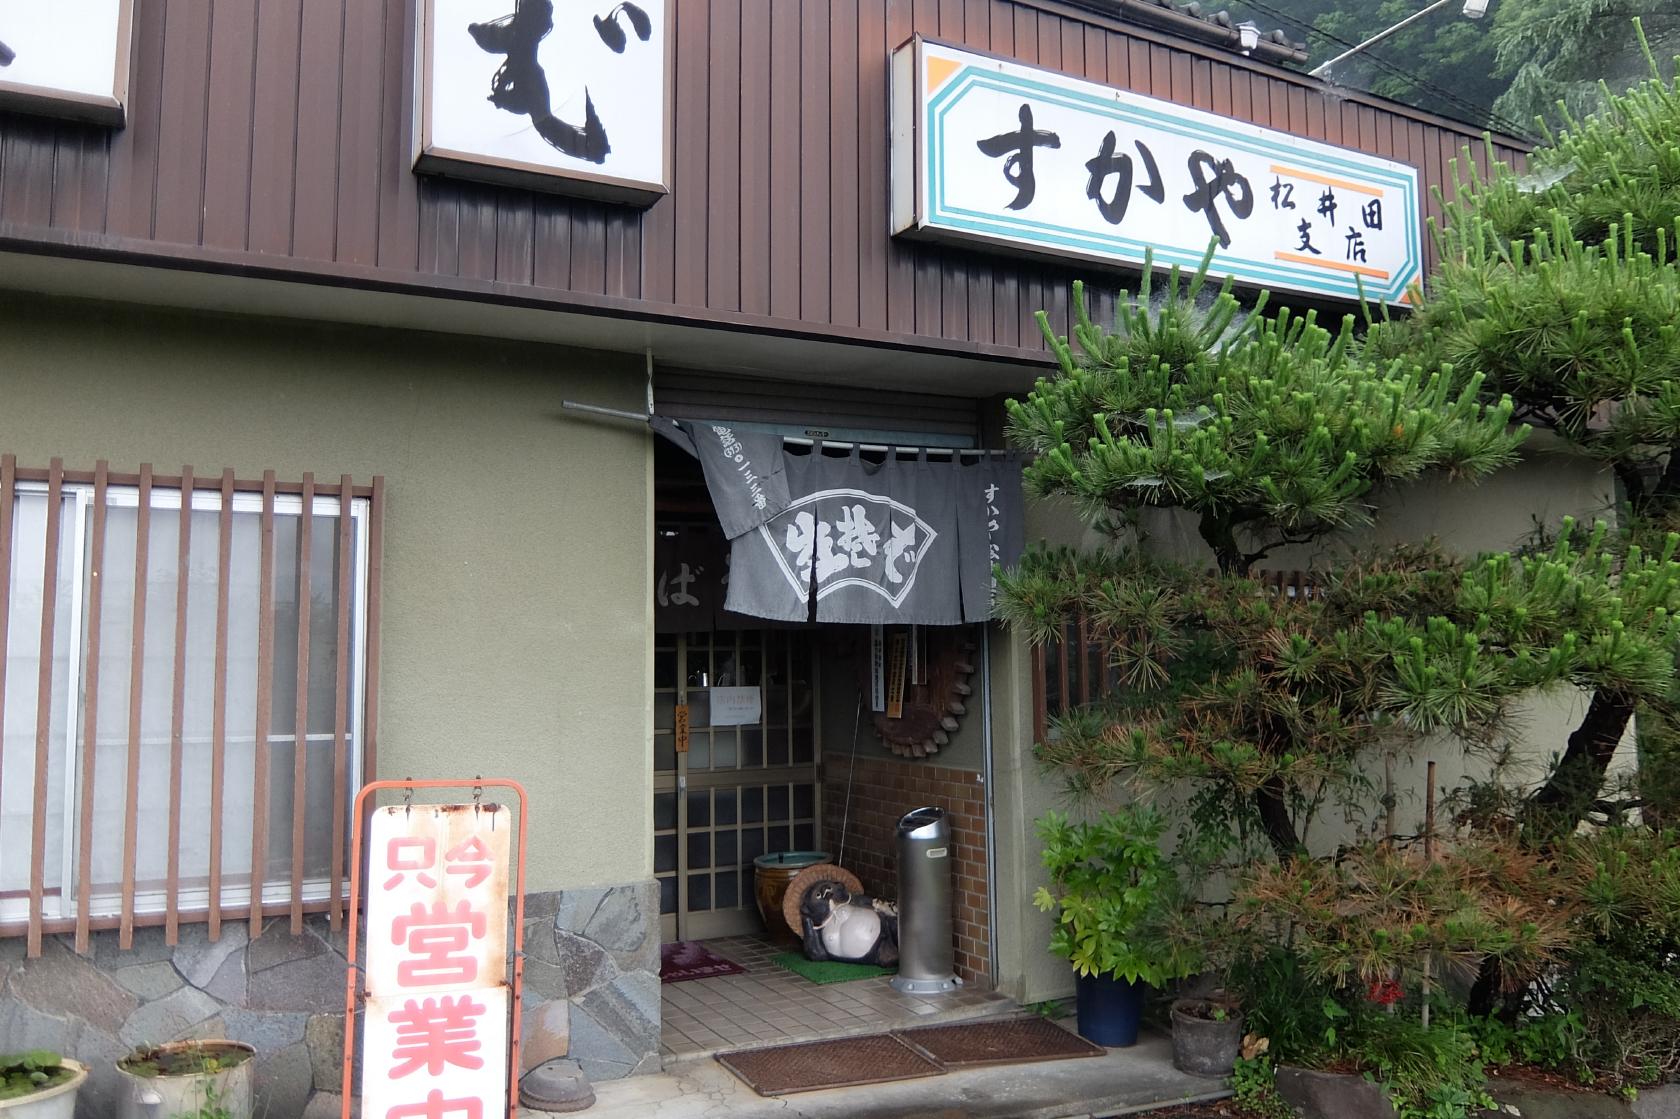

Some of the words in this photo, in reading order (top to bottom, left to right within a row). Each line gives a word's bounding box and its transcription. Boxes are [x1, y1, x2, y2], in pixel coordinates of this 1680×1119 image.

[976, 103, 1254, 249] すかや
[1269, 175, 1383, 231] 松井田
[1294, 217, 1367, 263] 支店
